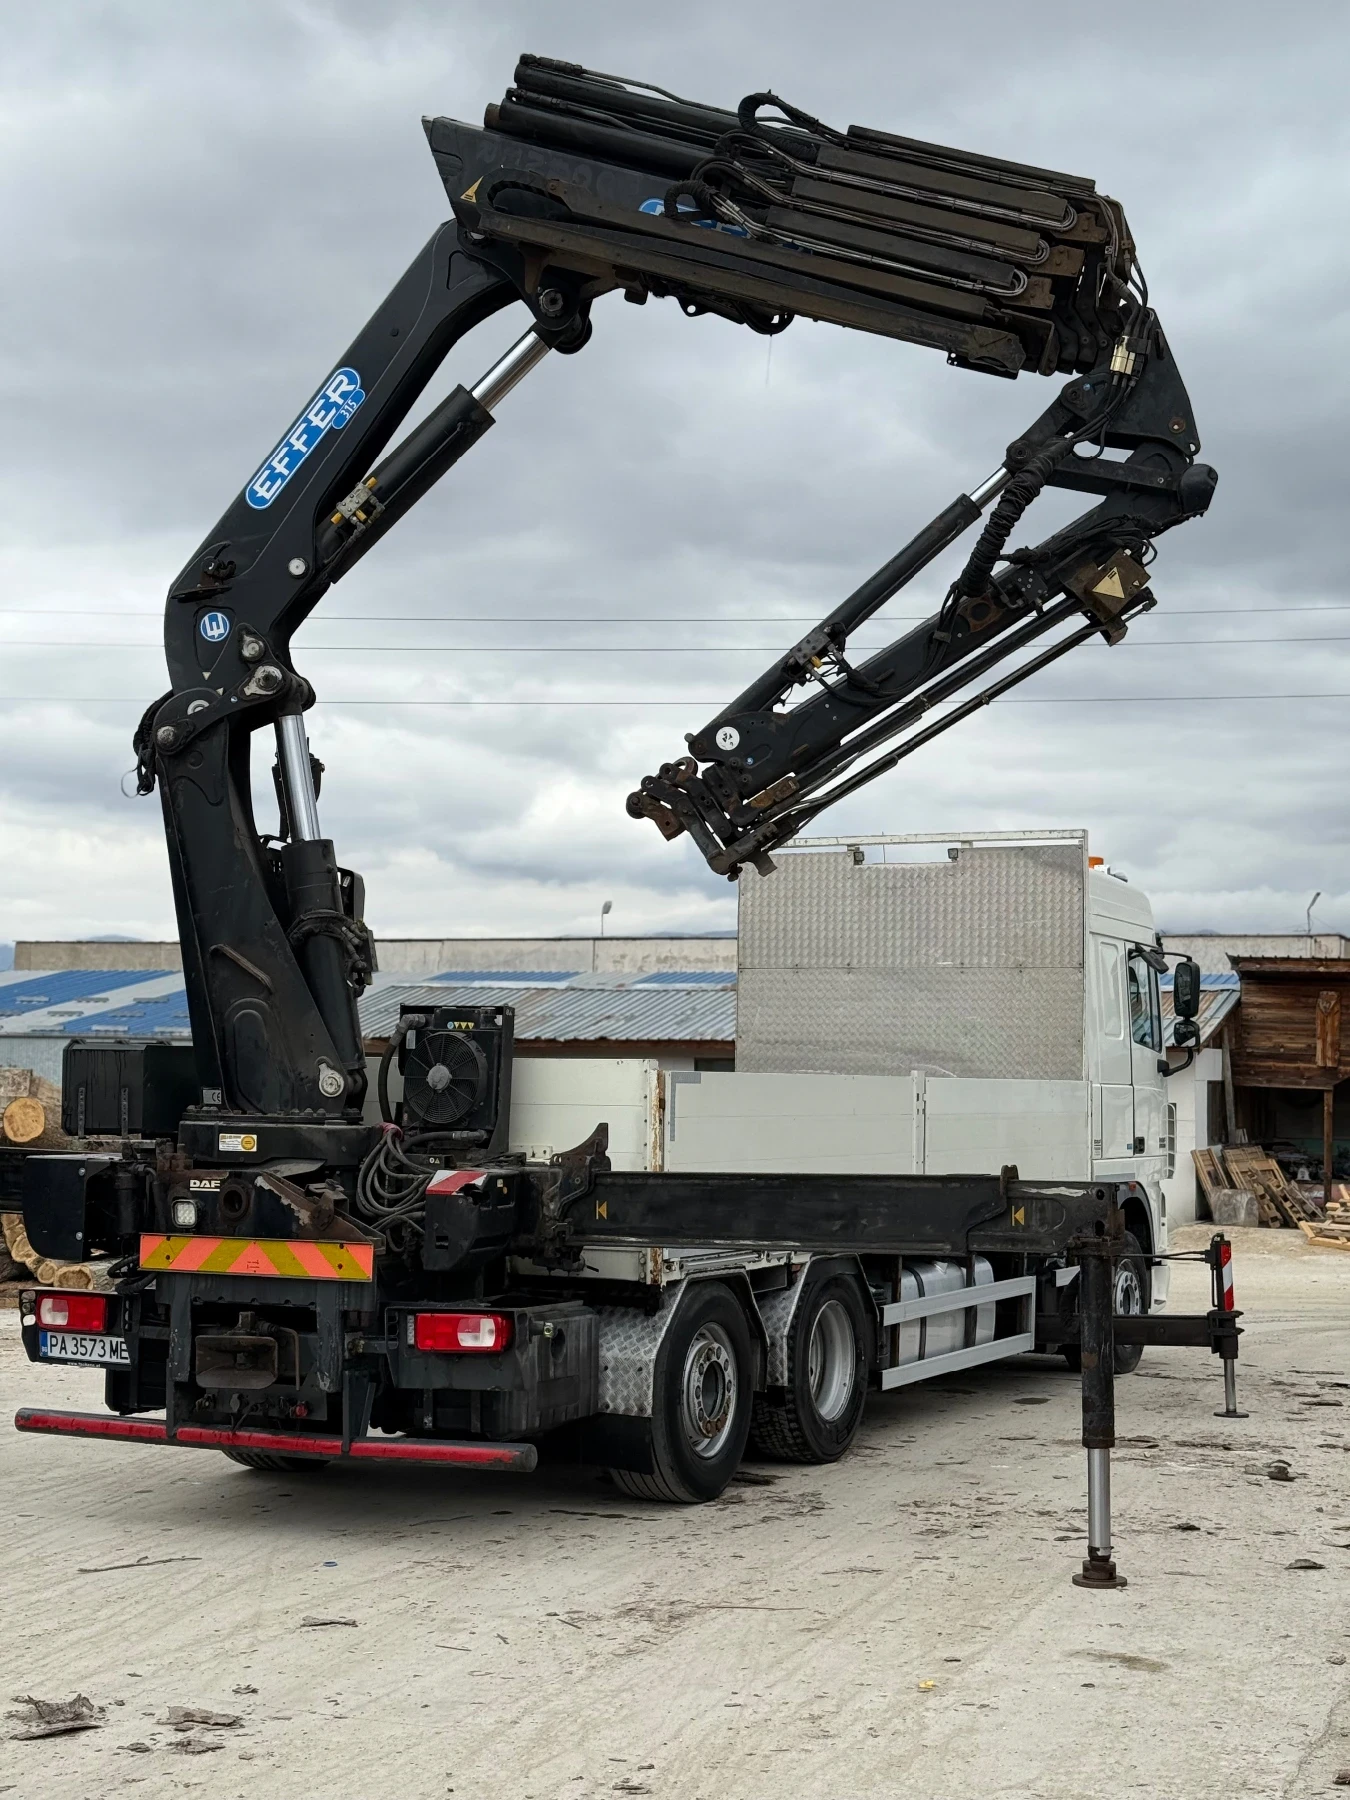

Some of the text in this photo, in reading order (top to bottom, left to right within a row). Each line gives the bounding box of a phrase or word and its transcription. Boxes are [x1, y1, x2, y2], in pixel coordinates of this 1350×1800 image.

[340, 399, 357, 419] 315
[253, 374, 356, 500] EFFER
[212, 1092, 221, 1102] CE
[190, 1180, 221, 1188] DAF
[49, 1335, 67, 1355] PA
[71, 1338, 106, 1358] 3573
